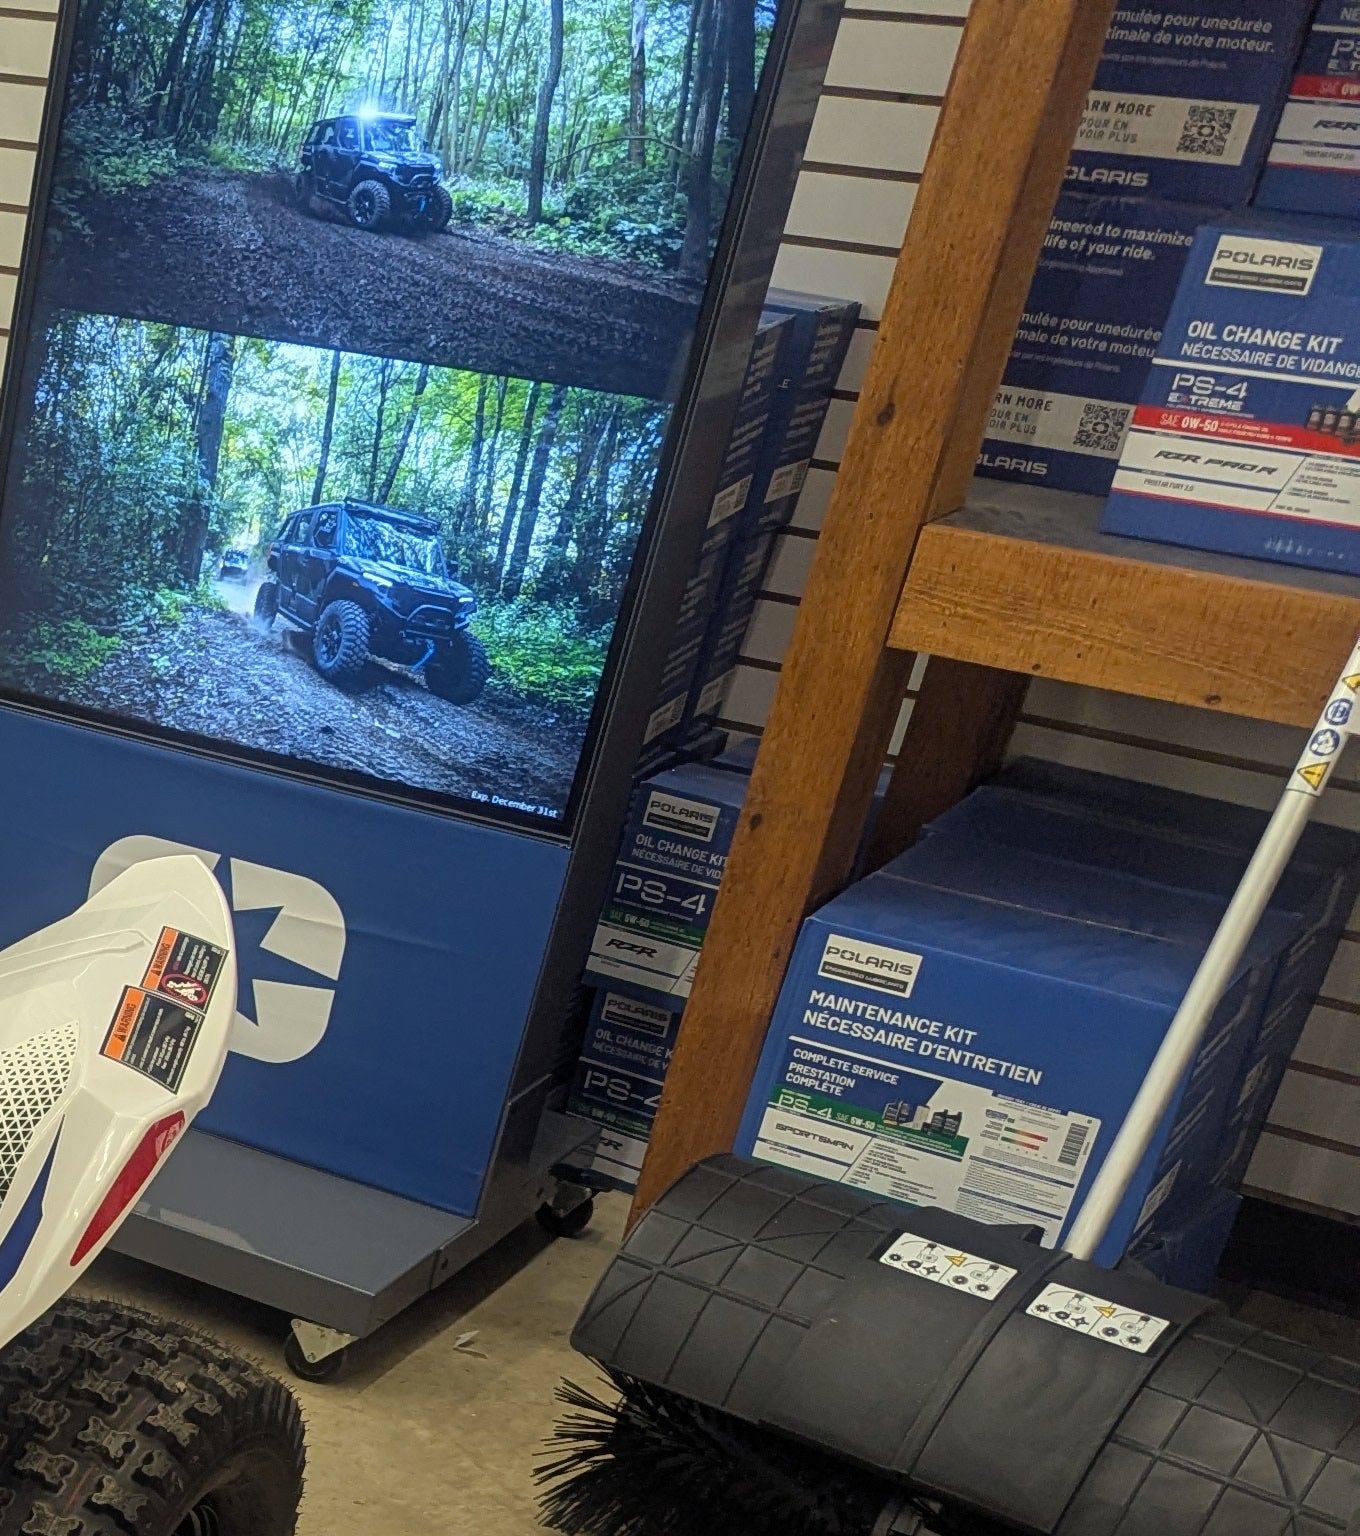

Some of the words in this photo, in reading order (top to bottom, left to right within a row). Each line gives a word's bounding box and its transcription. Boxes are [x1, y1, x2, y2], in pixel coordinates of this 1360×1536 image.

[1163, 14, 1197, 28] pour
[1153, 30, 1170, 44] de
[1174, 35, 1214, 47] votre
[1216, 39, 1274, 53] moteur.
[1116, 103, 1155, 117] MORE
[1108, 132, 1138, 144] PLUS
[1113, 121, 1128, 131] EN
[1064, 165, 1149, 187] OLARIS
[1044, 234, 1067, 249] life
[1070, 238, 1085, 252] of
[1087, 242, 1120, 260] your
[1122, 244, 1156, 261] ride.
[1106, 223, 1119, 238] to
[1123, 228, 1193, 247] maximize
[1216, 249, 1314, 271] POLARIS
[1061, 316, 1093, 332] pour
[1051, 330, 1068, 345] de
[1071, 335, 1107, 352] votre
[1110, 341, 1156, 358] moteu
[1188, 320, 1217, 341] OIL
[1223, 325, 1305, 351] CHANGE
[1307, 335, 1343, 354] KIT
[1181, 342, 1274, 367] NÉCESSAIRE
[1276, 355, 1298, 370] DE
[1172, 373, 1248, 399] PS-4
[1016, 395, 1053, 411] MORE
[1010, 421, 1037, 435] PLUS
[1014, 411, 1028, 423] EN
[1160, 413, 1179, 427] SAE
[1182, 416, 1219, 432] 0W-50
[976, 452, 1048, 475] LARIS
[1154, 450, 1202, 465] RZR
[1204, 458, 1255, 473] PRO
[1254, 466, 1278, 476] R
[492, 795, 536, 813] December
[537, 806, 558, 819] 31st
[650, 800, 714, 824] POLARIS
[636, 833, 655, 848] OIL
[657, 839, 707, 863] CHANGE
[632, 848, 690, 871] NÉCESSAIRE
[691, 863, 706, 875] DE
[616, 872, 706, 915] PS-4
[152, 941, 170, 970] WARNING
[606, 938, 658, 958] RZR
[826, 946, 915, 976] POLARIS
[117, 1001, 136, 1034] WARNING
[608, 999, 669, 1022] POLARIS
[809, 989, 943, 1038] MAINTENANCE
[944, 1025, 977, 1046] KIT
[595, 1028, 612, 1041] OIL
[616, 1034, 663, 1056] CHANGE
[803, 1009, 922, 1052] NÉCESSAIRE
[919, 1041, 1043, 1086] D'ENTRETIEN
[788, 1062, 856, 1088] PRESTATION
[793, 1048, 850, 1071] COMPLETE
[851, 1063, 900, 1086] SERVICE
[785, 1072, 844, 1097] COMPLÈTE
[779, 1093, 833, 1121] PS-4
[836, 1111, 849, 1123] SAE
[775, 1122, 855, 1151] SPORTSMAN
